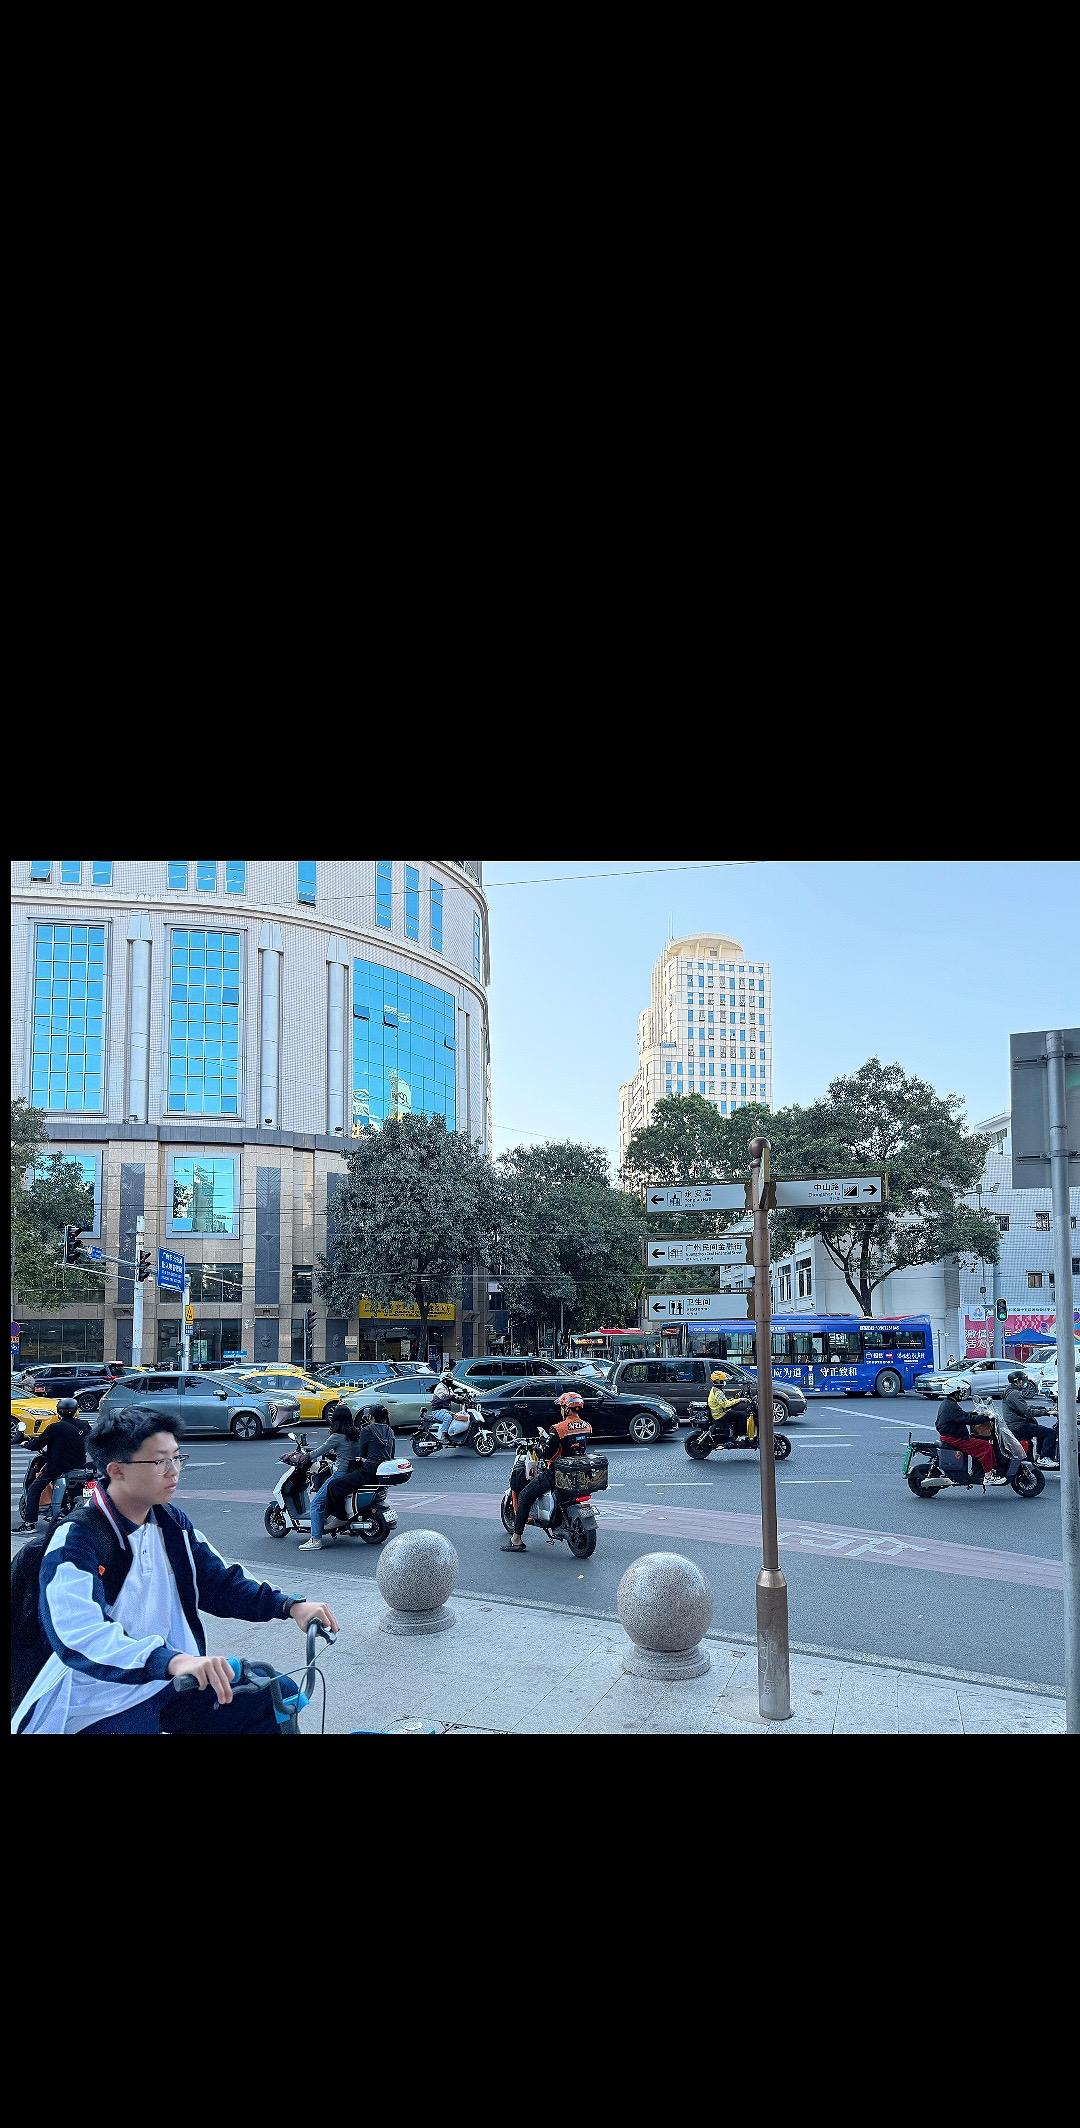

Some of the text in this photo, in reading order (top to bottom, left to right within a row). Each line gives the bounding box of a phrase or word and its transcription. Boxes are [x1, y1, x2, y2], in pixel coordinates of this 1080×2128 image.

[813, 1182, 839, 1191] 中山路
[685, 1242, 742, 1251] 广州民间金融街
[686, 1298, 711, 1306] 卫生间
[771, 1366, 858, 1378] 应为道 守正致和
